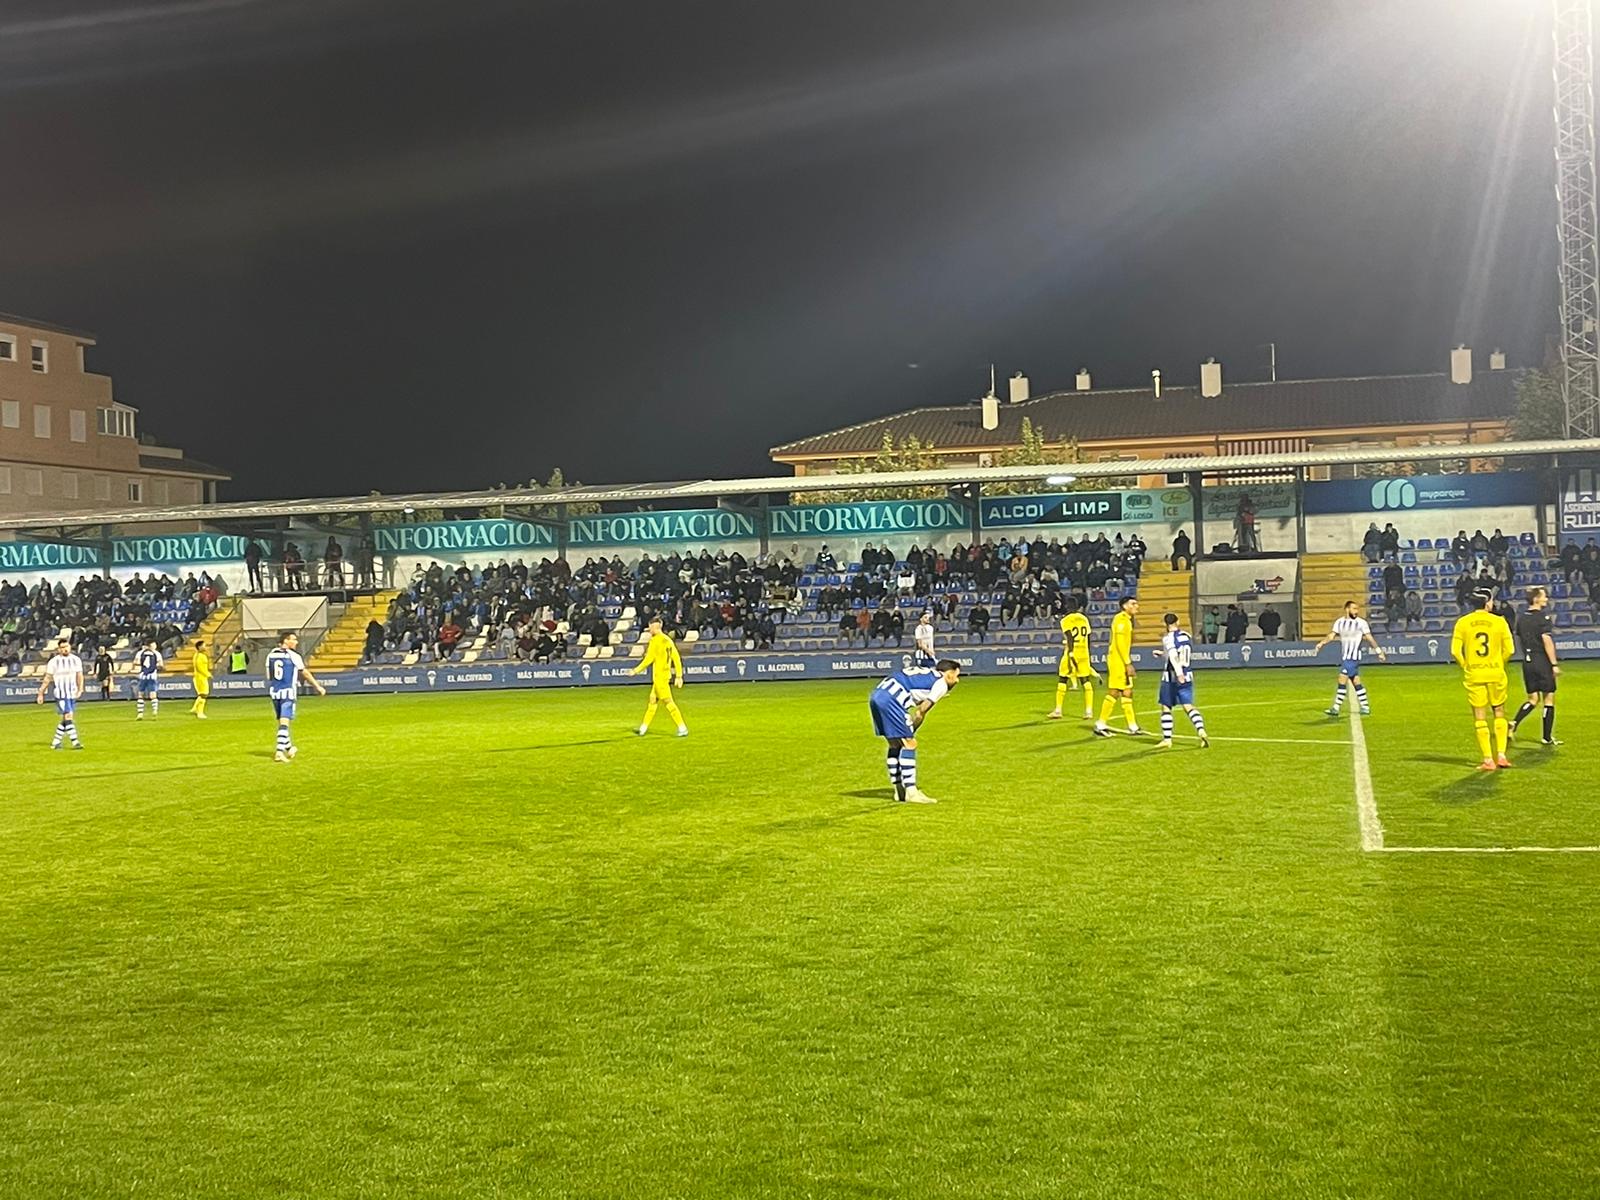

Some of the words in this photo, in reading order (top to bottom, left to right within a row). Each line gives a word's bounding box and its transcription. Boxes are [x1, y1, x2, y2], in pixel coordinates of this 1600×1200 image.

[771, 503, 964, 533] INFORMACION
[988, 504, 1044, 519] ALCOI
[1062, 501, 1110, 515] LIMP
[373, 522, 552, 550] INFORMACION
[569, 513, 754, 543] INFORMACION
[1264, 650, 1274, 658] EL
[1475, 631, 1489, 657] 3
[273, 659, 284, 680] 6
[1042, 655, 1057, 665] QUE
